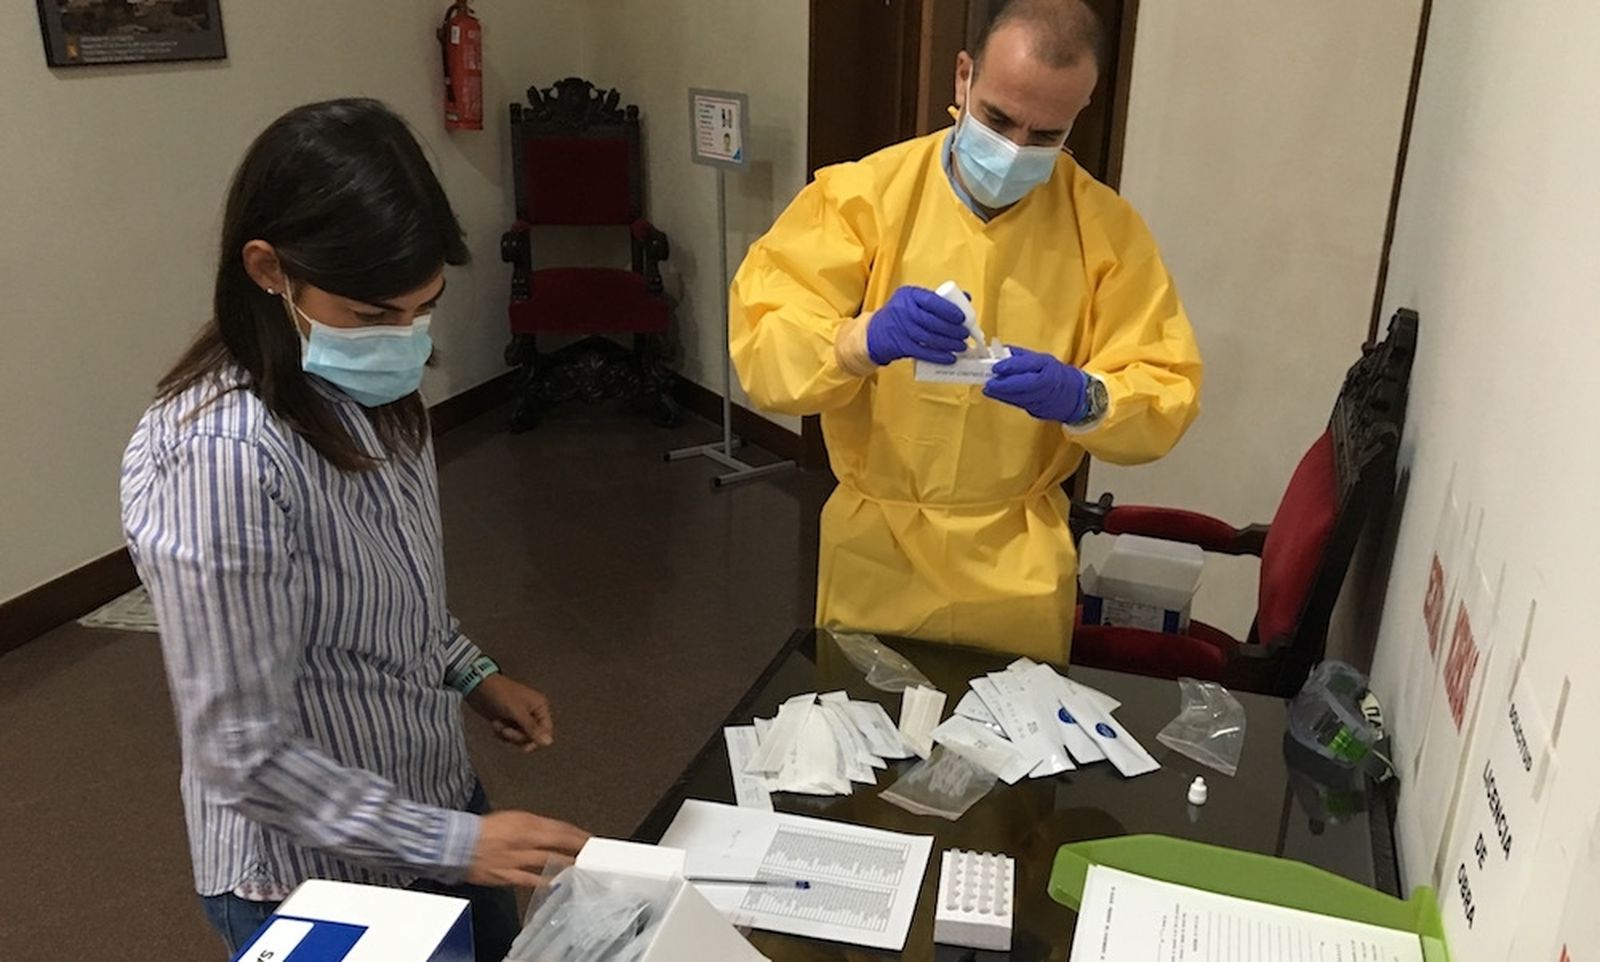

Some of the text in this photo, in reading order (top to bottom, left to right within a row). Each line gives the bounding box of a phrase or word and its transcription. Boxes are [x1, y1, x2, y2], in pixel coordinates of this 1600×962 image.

[1483, 759, 1512, 861] LICENCIA
[1475, 831, 1488, 870] DE
[1457, 862, 1475, 930] OBRA
